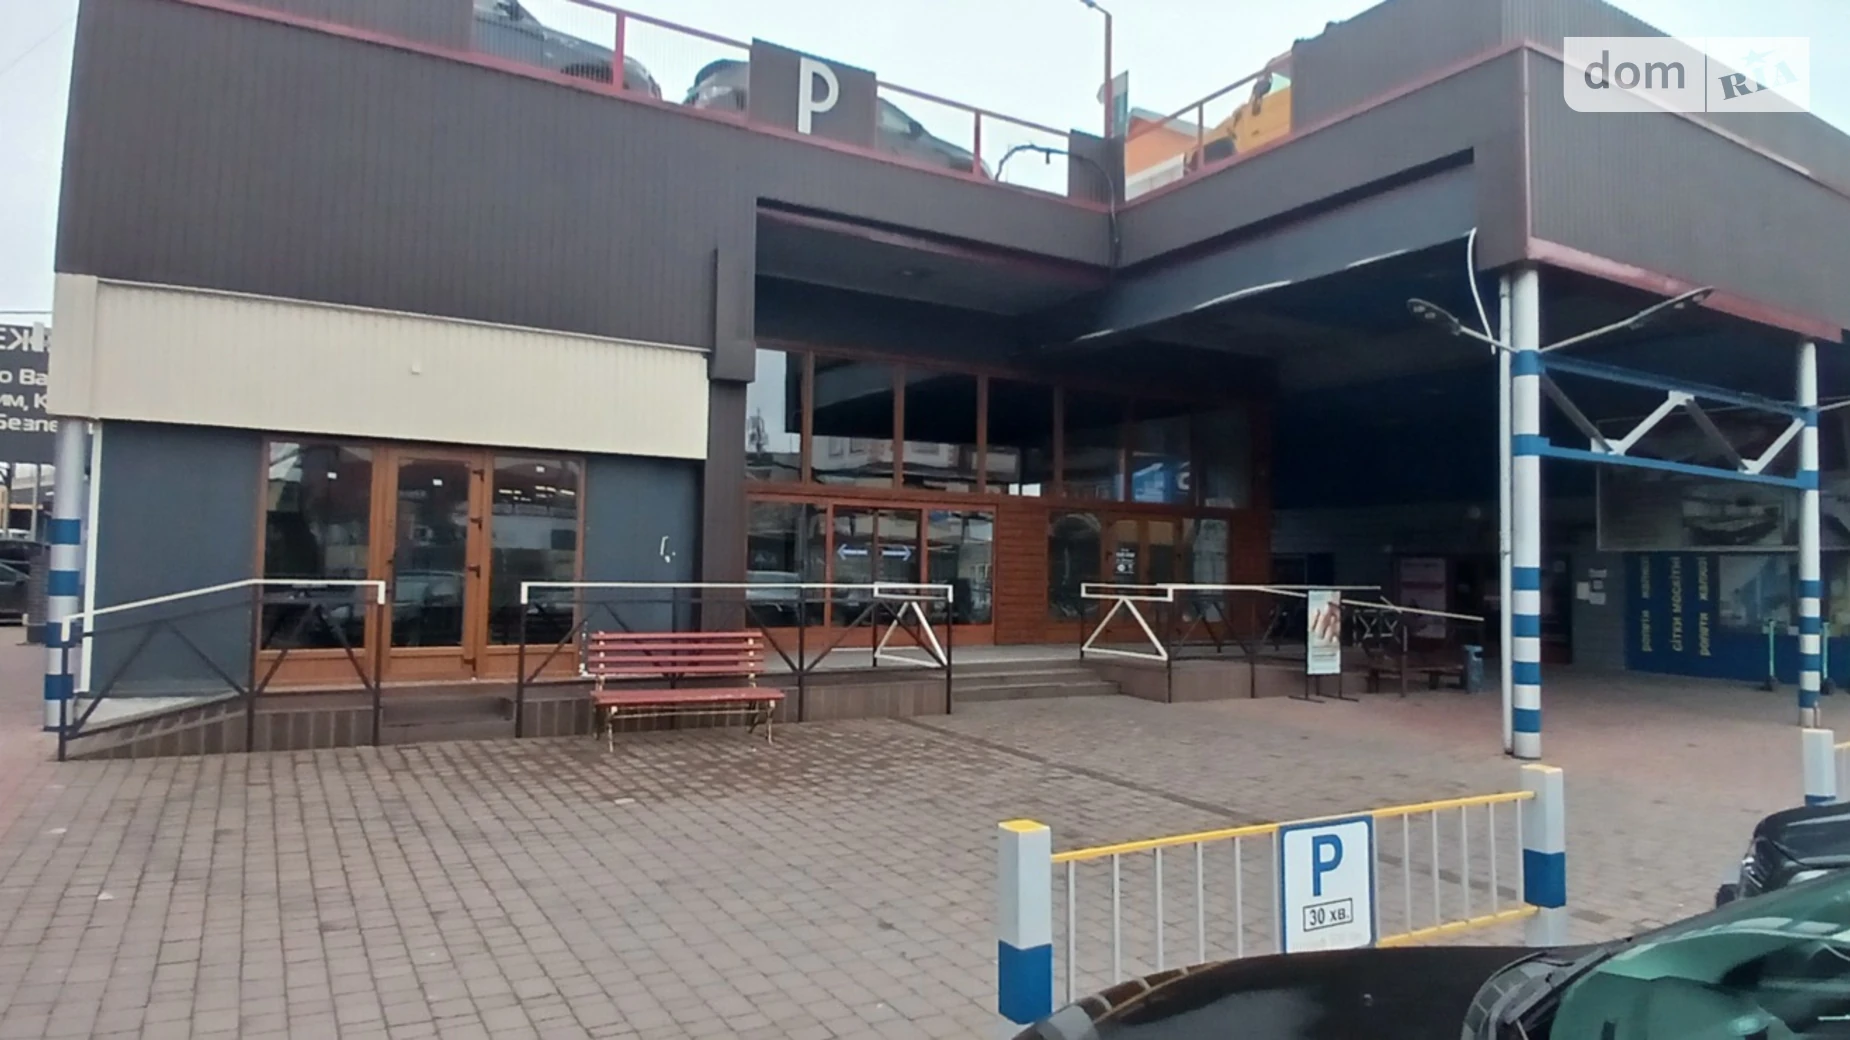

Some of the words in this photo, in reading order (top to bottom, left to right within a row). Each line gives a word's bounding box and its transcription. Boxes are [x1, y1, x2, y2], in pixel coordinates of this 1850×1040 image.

[797, 57, 840, 134] P
[1311, 833, 1343, 897] P
[1309, 907, 1326, 926] 30
[1329, 908, 1350, 922] хв.
